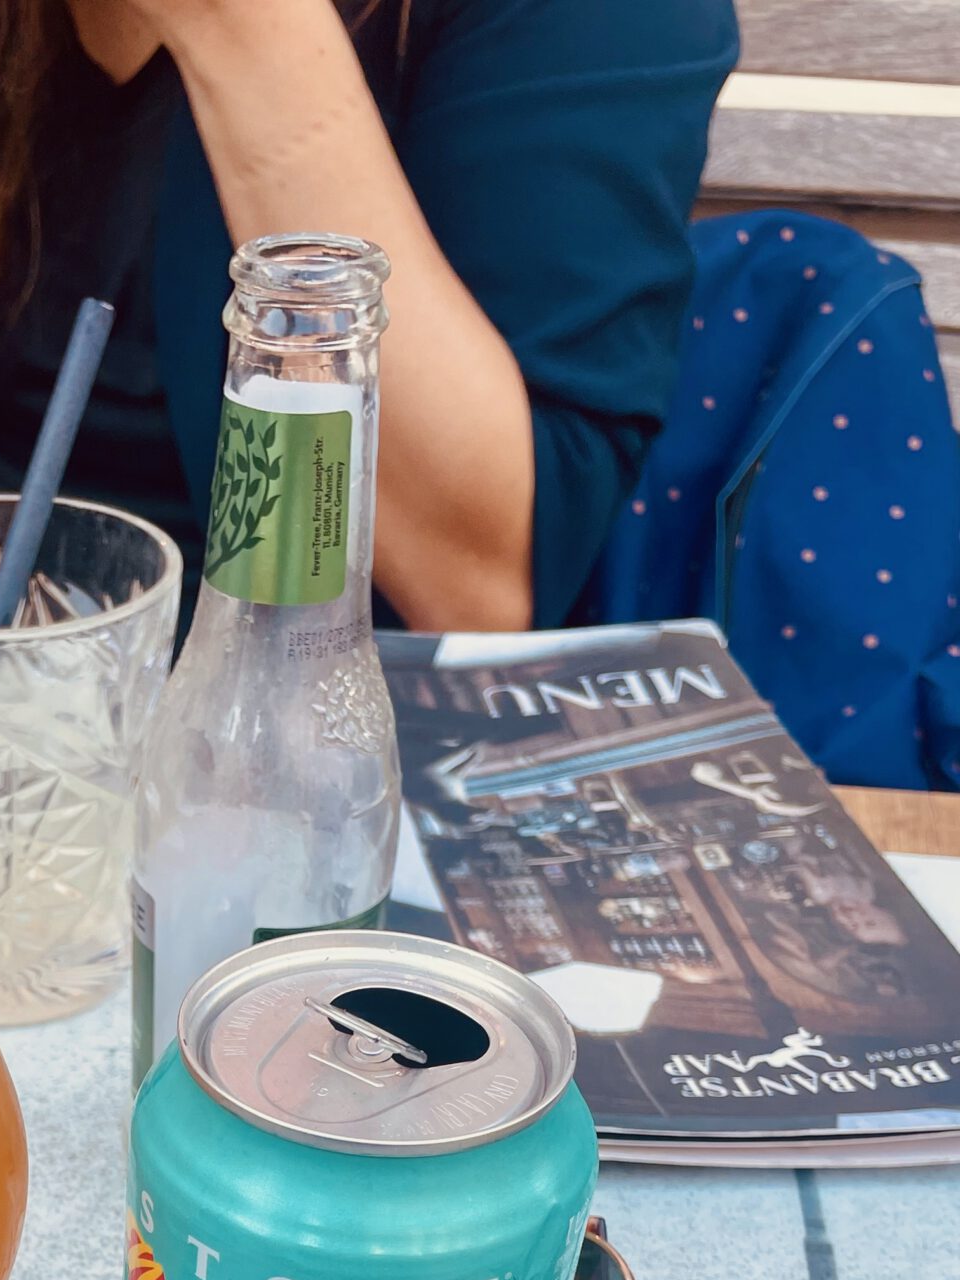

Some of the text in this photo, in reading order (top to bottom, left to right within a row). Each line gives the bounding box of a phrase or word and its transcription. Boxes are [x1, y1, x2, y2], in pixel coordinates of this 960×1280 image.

[334, 461, 345, 507] Germany
[482, 663, 728, 719] MENU
[661, 1050, 748, 1077] AAP
[864, 1039, 960, 1065] STERDAM
[670, 1056, 951, 1099] BRABANTSE
